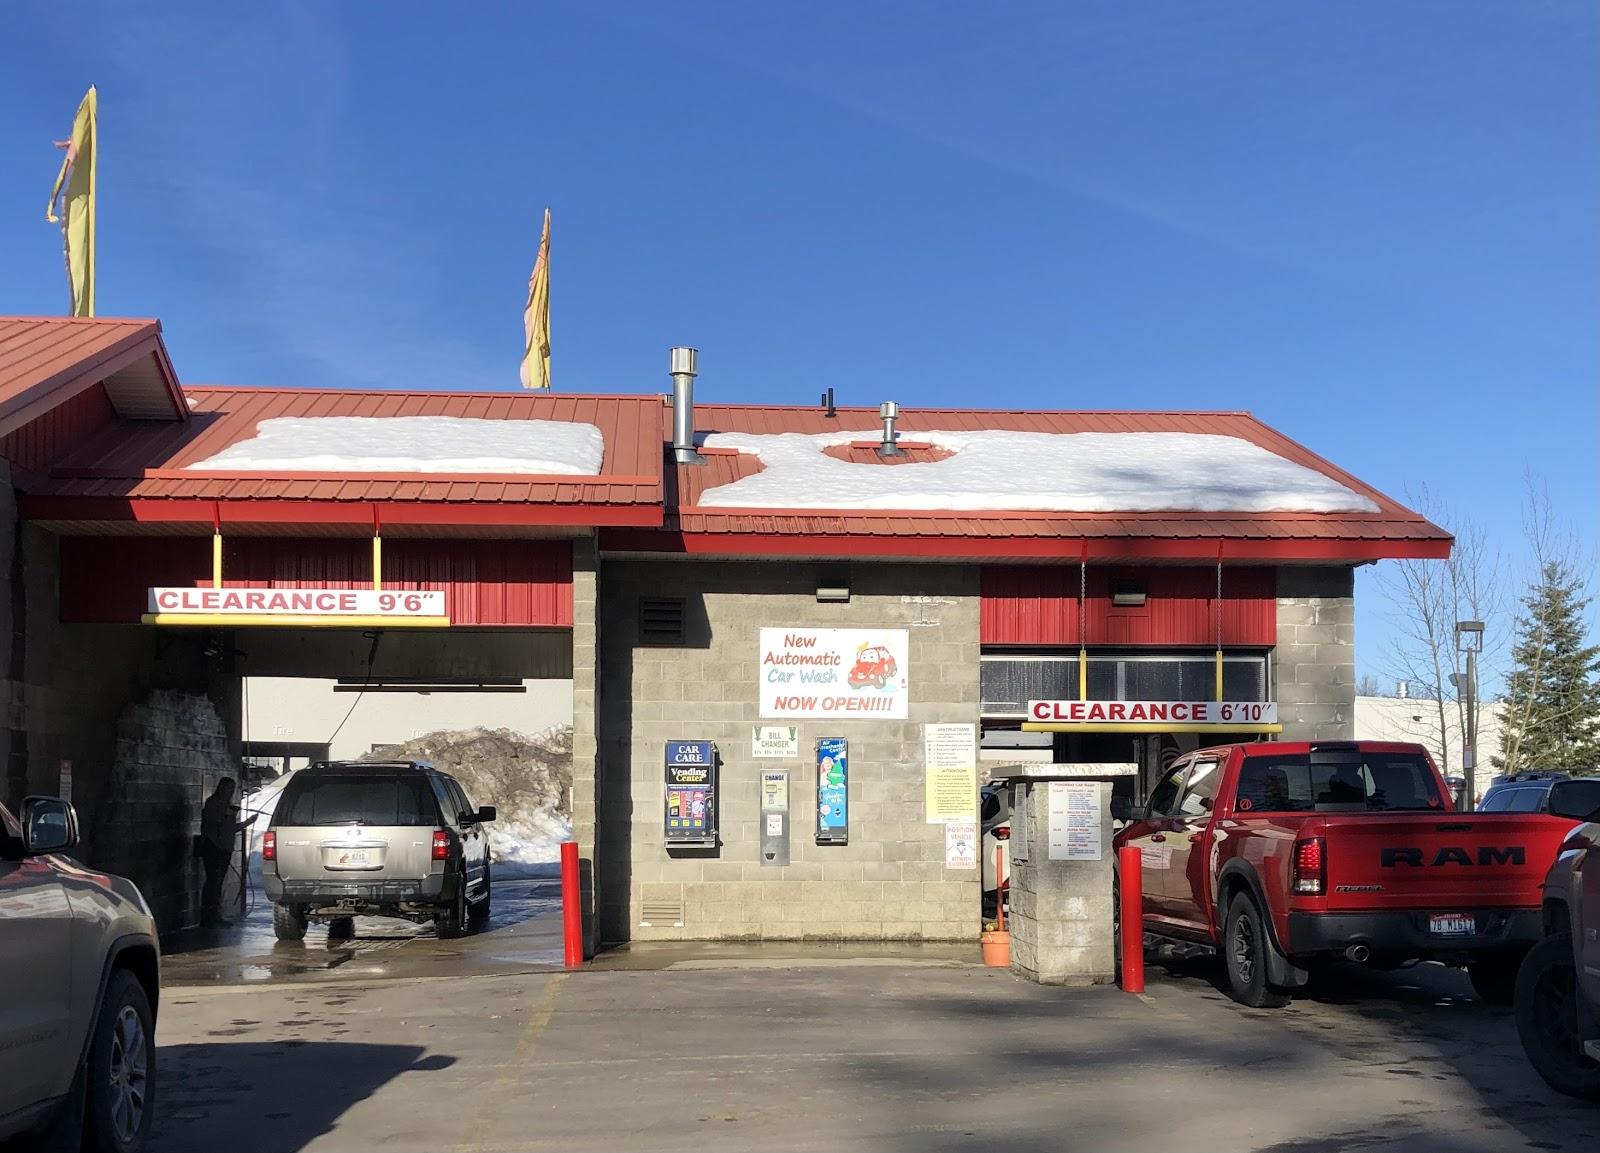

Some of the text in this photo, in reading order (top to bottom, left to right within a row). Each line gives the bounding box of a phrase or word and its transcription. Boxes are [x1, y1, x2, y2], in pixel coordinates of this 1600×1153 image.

[158, 591, 434, 612] CLEARANCE 9'6"
[783, 634, 817, 648] New
[763, 651, 841, 666] Automatic
[767, 668, 839, 684] Car Wash
[774, 696, 893, 711] NOW OPEN!!!!
[1033, 702, 1272, 721] CLEARANCE 6'10"
[769, 732, 782, 740] BILL
[678, 745, 700, 754] CAR
[761, 740, 789, 748] CHANGER
[675, 754, 704, 763] CARE
[670, 767, 708, 778] Vending
[675, 774, 704, 782] Center
[1381, 846, 1526, 867] RAM
